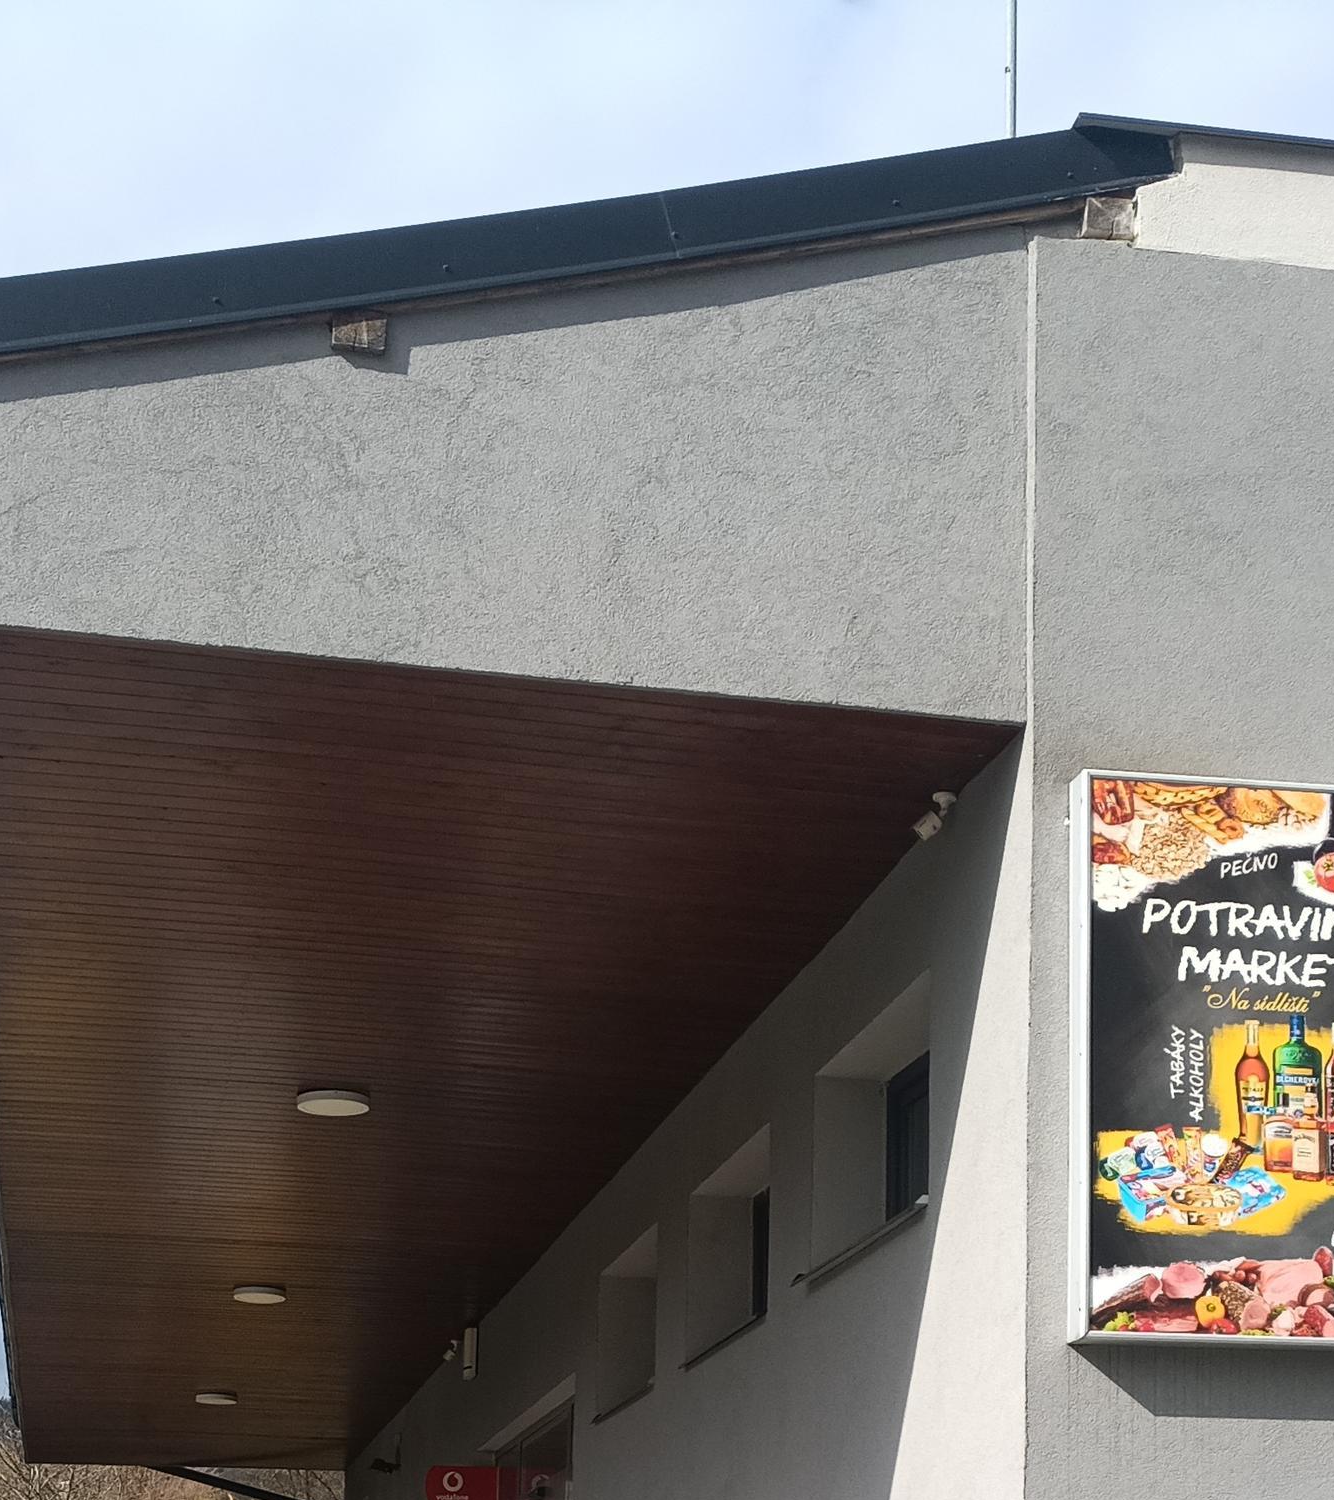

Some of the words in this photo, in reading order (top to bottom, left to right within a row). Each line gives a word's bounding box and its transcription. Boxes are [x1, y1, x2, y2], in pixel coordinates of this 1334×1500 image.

[1220, 852, 1279, 879] PEČNO
[1163, 1024, 1186, 1099] TABÁKY
[1188, 1028, 1204, 1122] ALKOHOLY
